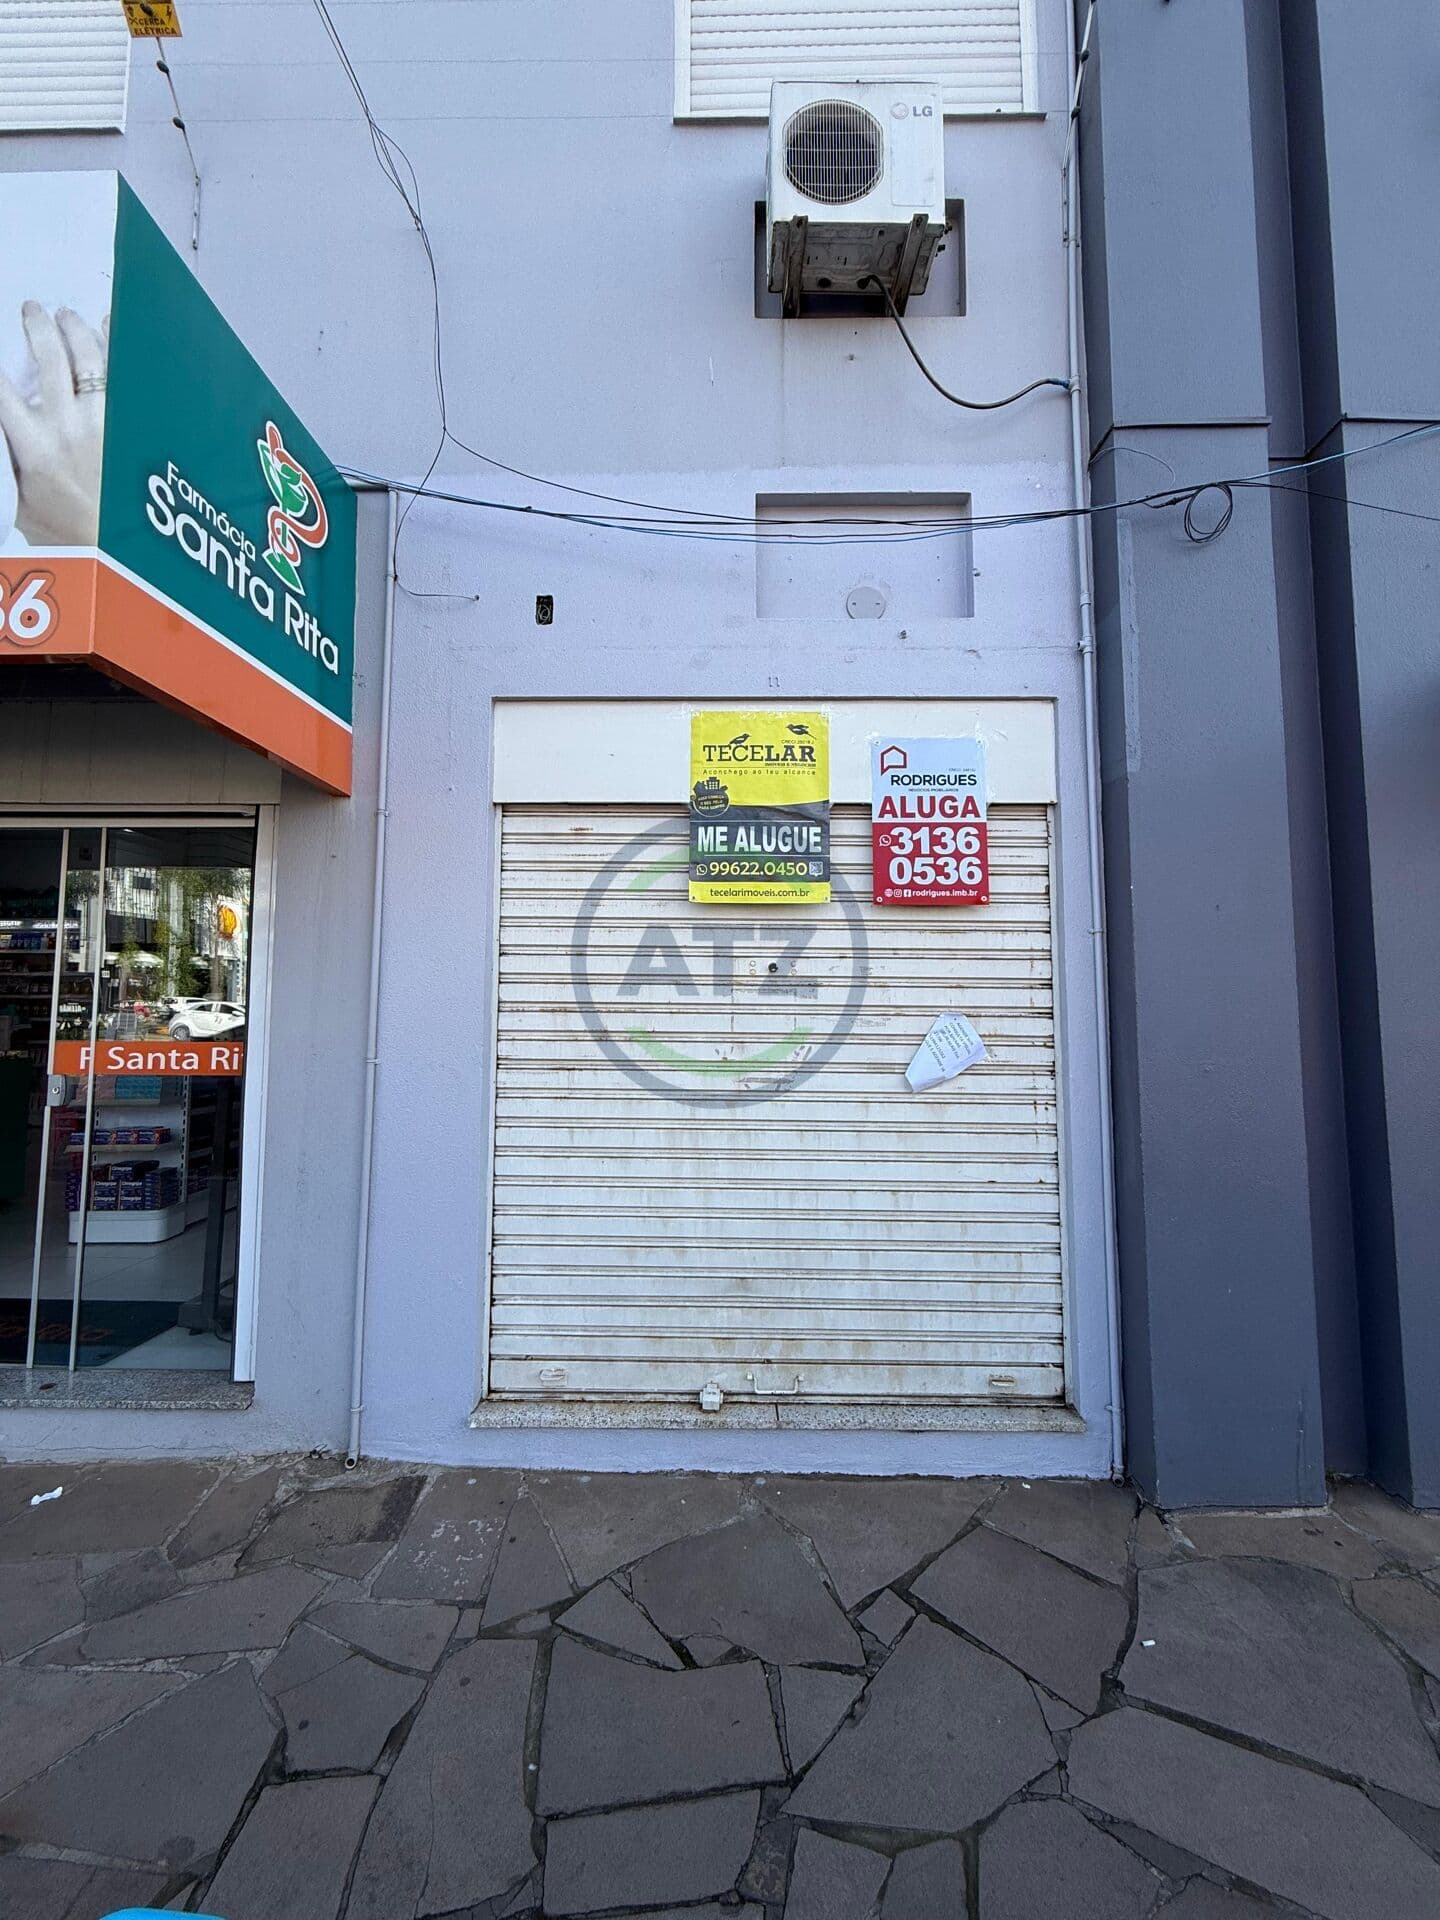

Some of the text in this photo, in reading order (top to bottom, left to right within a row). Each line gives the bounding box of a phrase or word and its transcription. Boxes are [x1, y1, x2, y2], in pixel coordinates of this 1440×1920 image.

[139, 17, 165, 25] CERCA
[912, 105, 933, 117] LG
[167, 461, 257, 562] Farmácia
[146, 474, 339, 676] Santa Rita
[0, 579, 51, 639] 6
[703, 745, 816, 762] TECELAR
[890, 774, 977, 786] RODRIGUES
[878, 795, 981, 819] ALUGA
[698, 826, 822, 853] ME ALUGUE
[890, 826, 980, 855] 3136
[710, 861, 808, 876] 99622.0450
[889, 857, 983, 885] 0536
[710, 888, 811, 899] tecelarimoveis.com.br
[912, 888, 978, 898] rodrigues.imb.br
[107, 1046, 199, 1070] Santa
[210, 1047, 244, 1070] Ri
